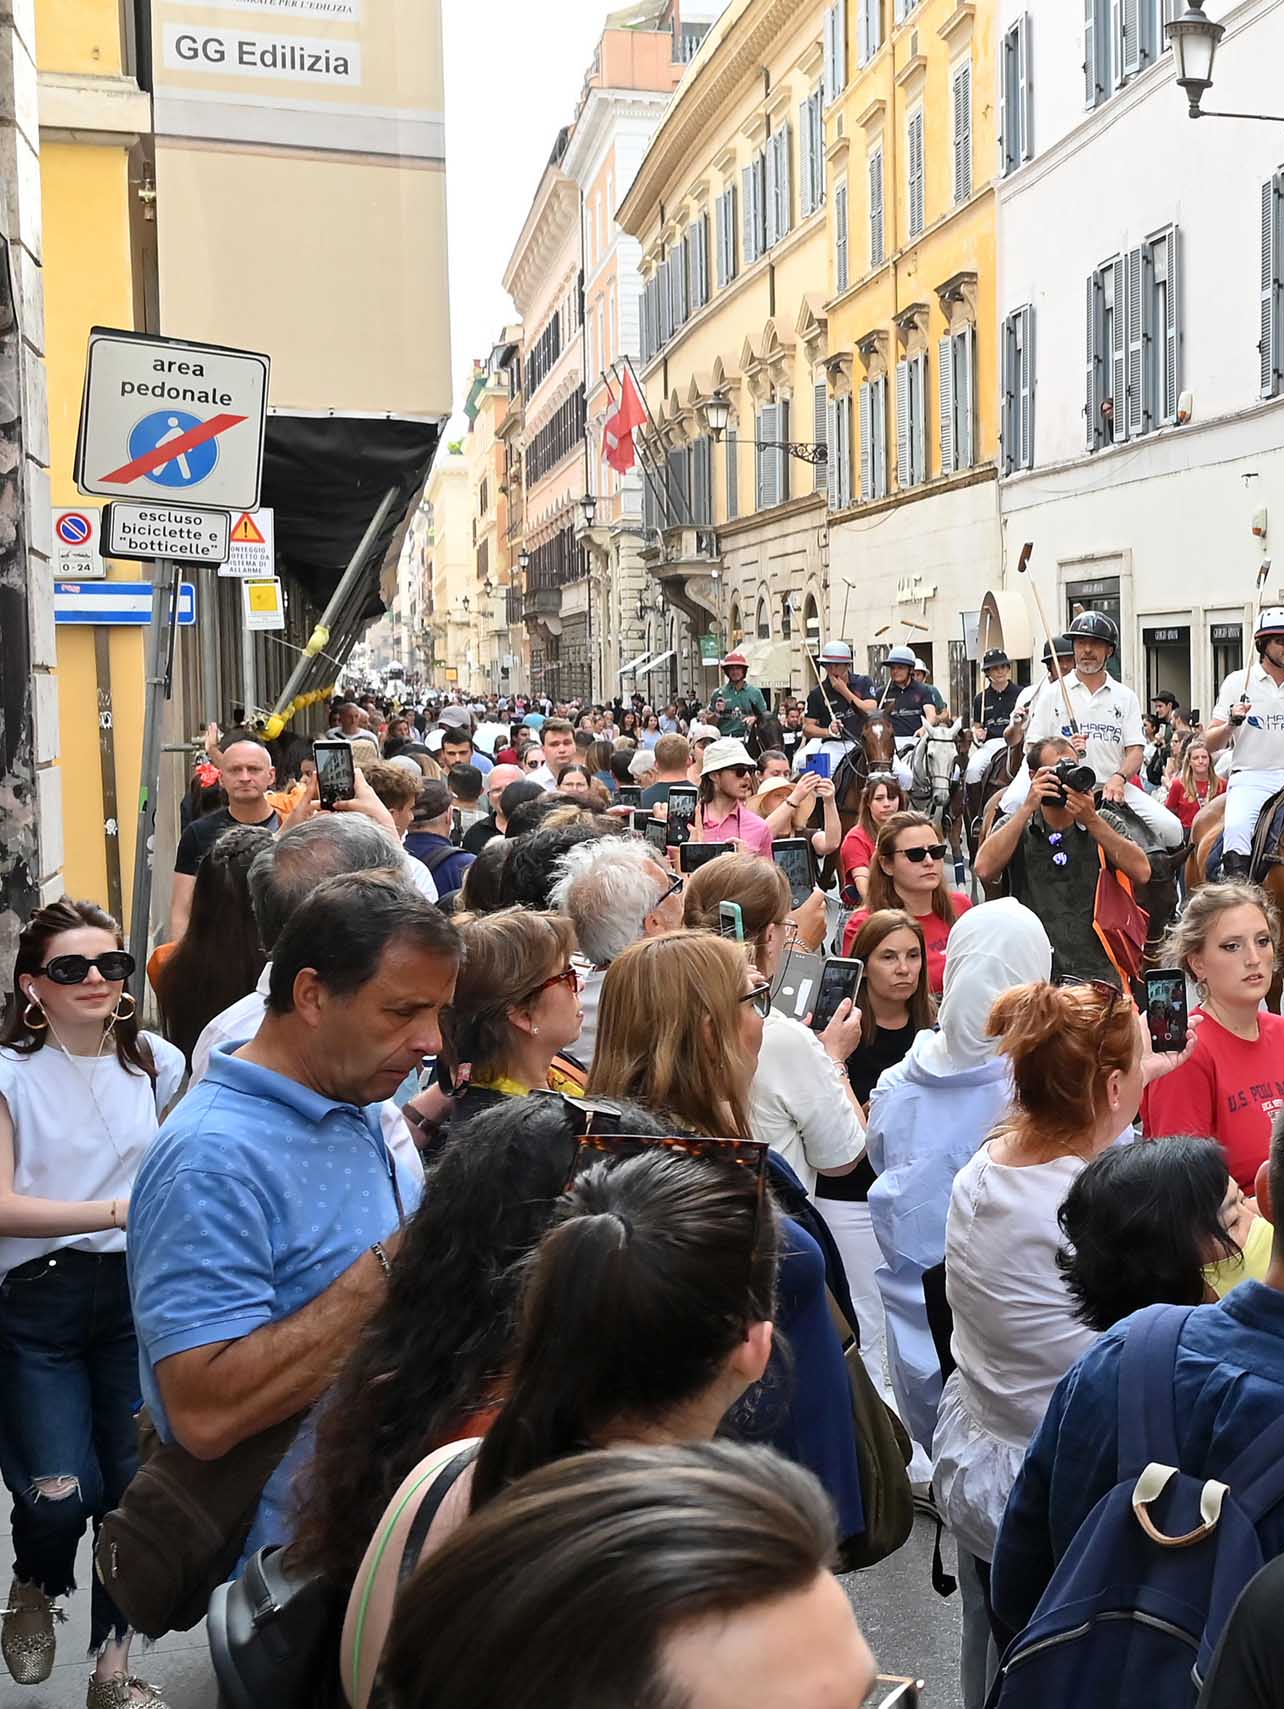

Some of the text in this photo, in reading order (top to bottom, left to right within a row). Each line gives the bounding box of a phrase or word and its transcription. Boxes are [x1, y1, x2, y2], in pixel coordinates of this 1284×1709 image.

[174, 35, 350, 75] GG Edilizia
[153, 358, 205, 377] area
[120, 380, 233, 406] pedonale
[139, 511, 203, 526] escluso
[122, 522, 218, 542] biciclette e
[119, 536, 218, 556] "botticelle"
[230, 546, 266, 554] ONTEGGIO
[229, 566, 262, 574] ALLARME
[1079, 722, 1122, 736] HARPA
